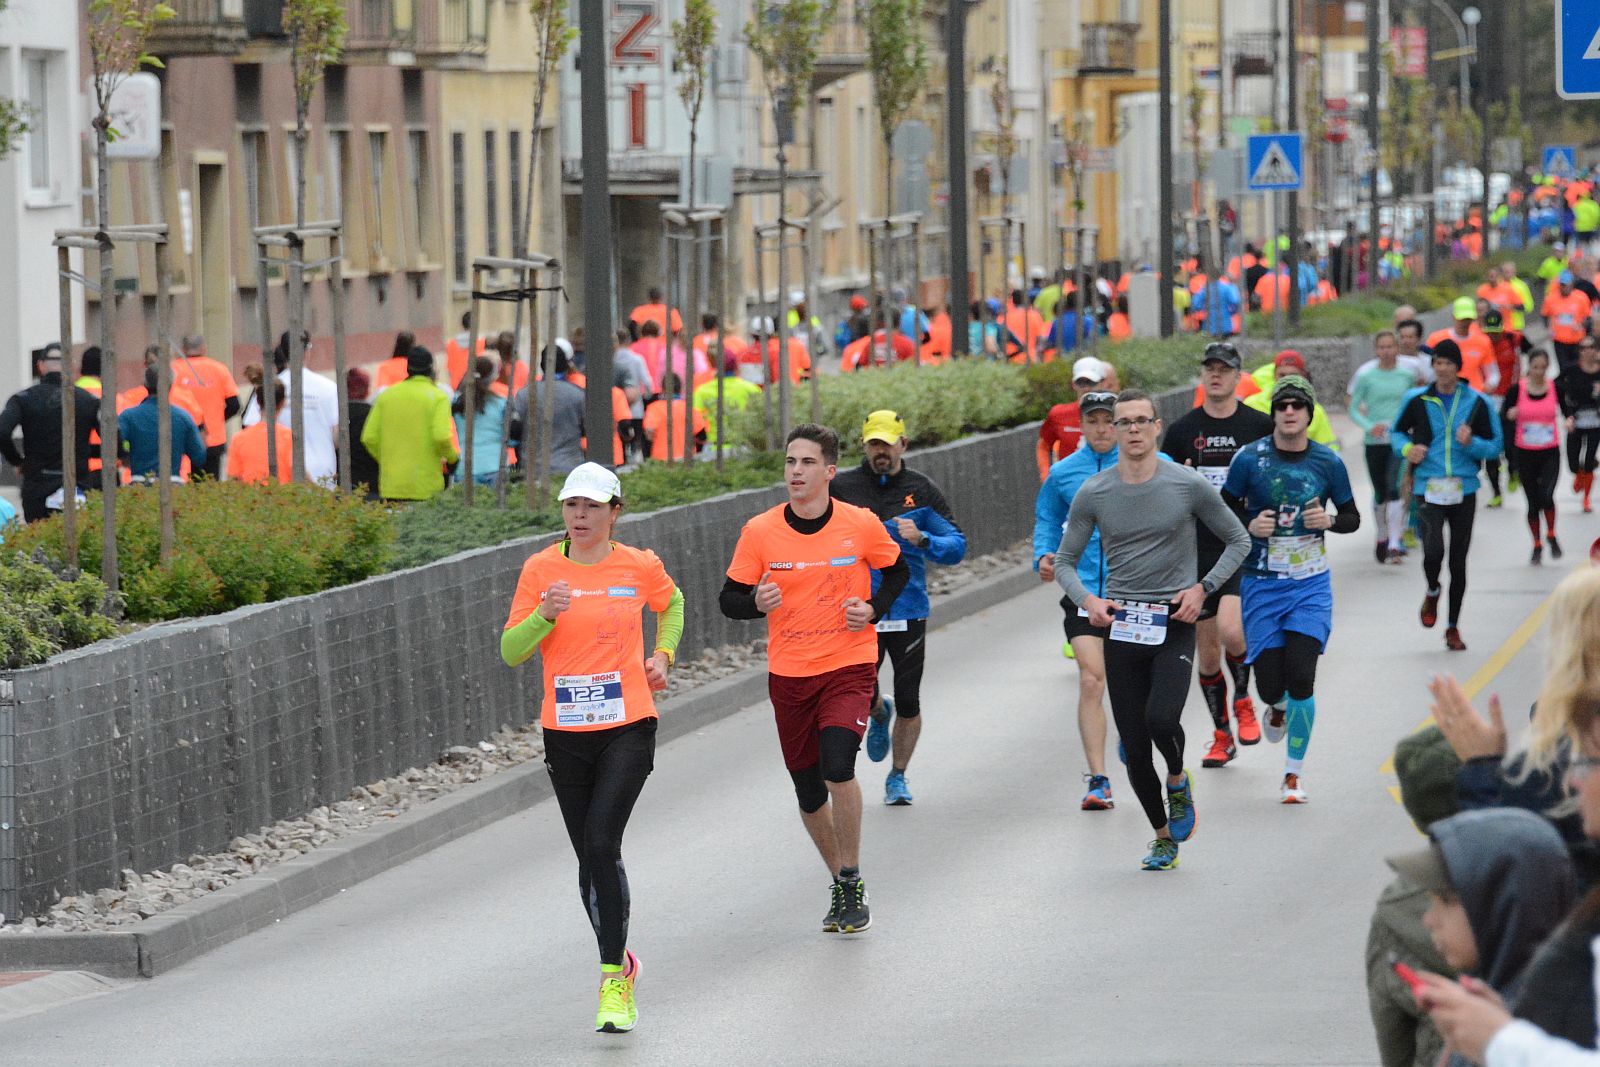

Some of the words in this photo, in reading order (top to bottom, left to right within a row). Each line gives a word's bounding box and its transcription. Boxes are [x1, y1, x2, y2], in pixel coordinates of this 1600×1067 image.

[1194, 435, 1237, 449] OPERA
[1125, 610, 1154, 625] 215
[568, 685, 605, 702] 122
